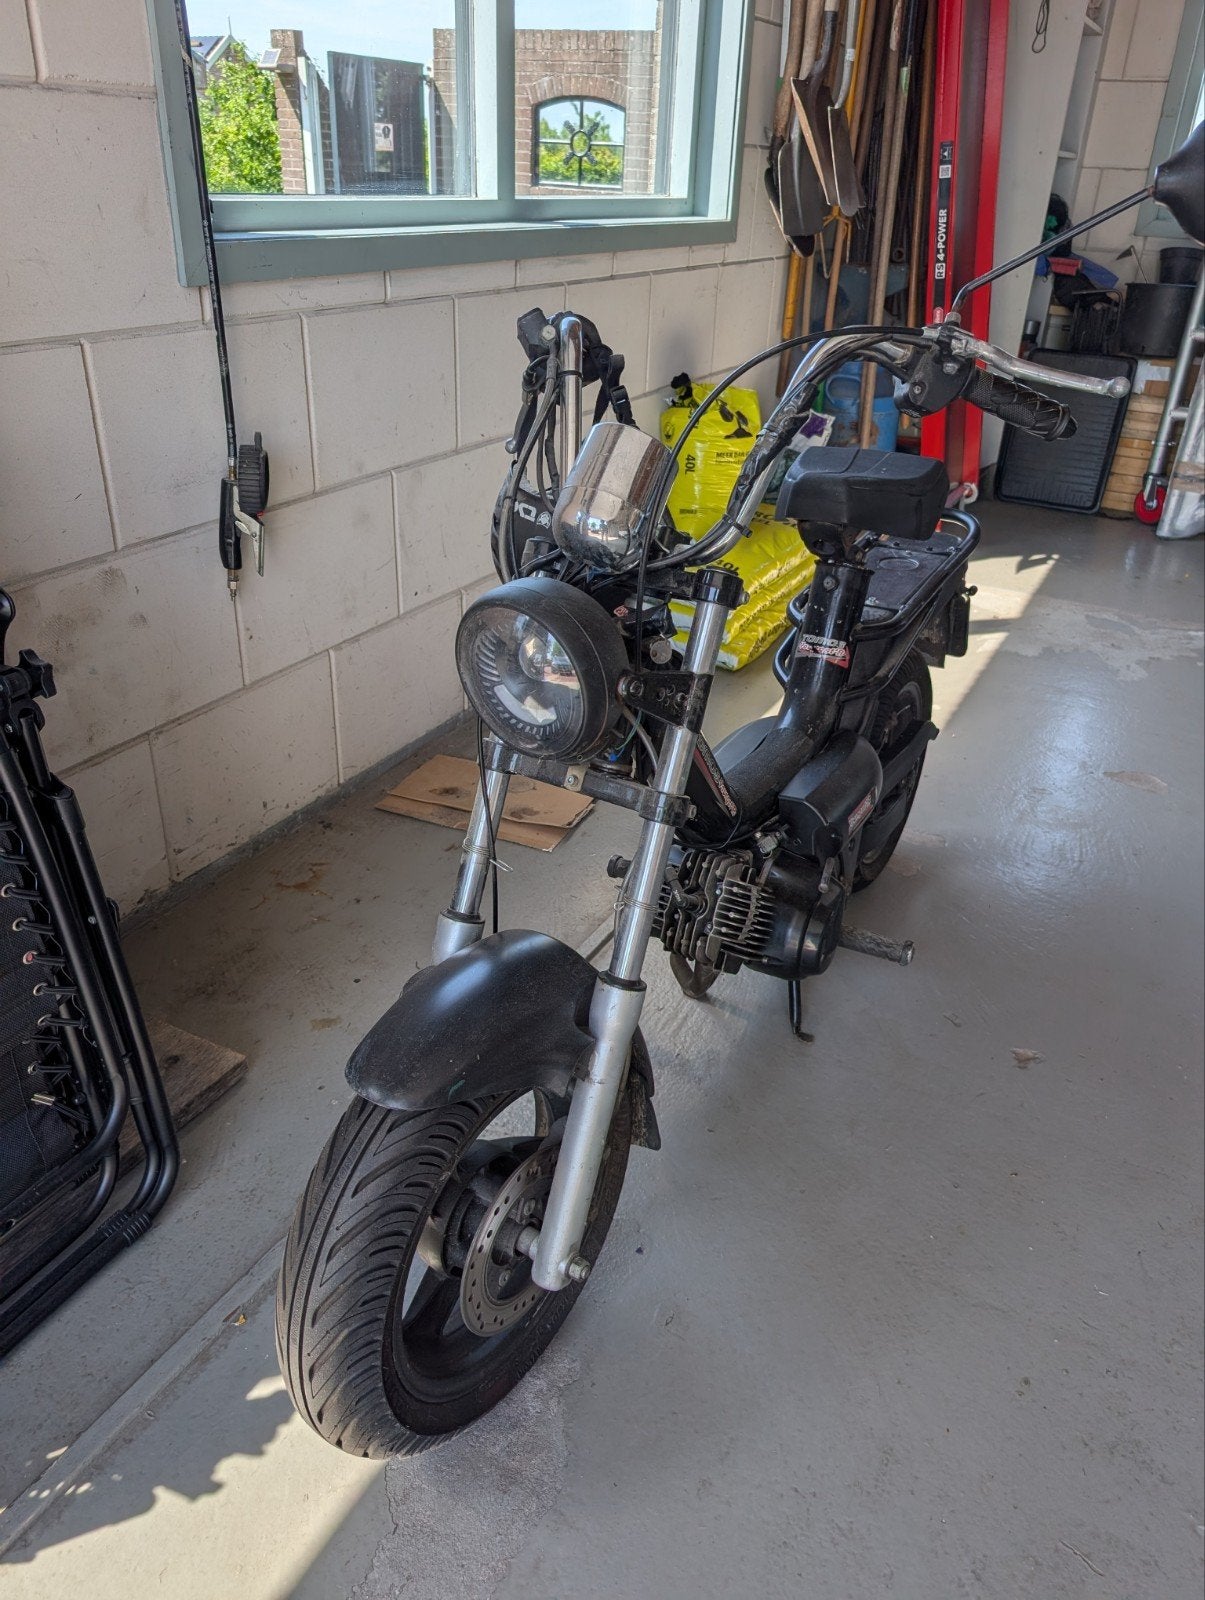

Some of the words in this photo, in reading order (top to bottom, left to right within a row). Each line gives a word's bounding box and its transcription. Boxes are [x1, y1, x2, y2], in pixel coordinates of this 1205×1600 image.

[937, 209, 947, 261] 4-POWER
[936, 264, 945, 278] RS
[685, 454, 696, 475] 40L
